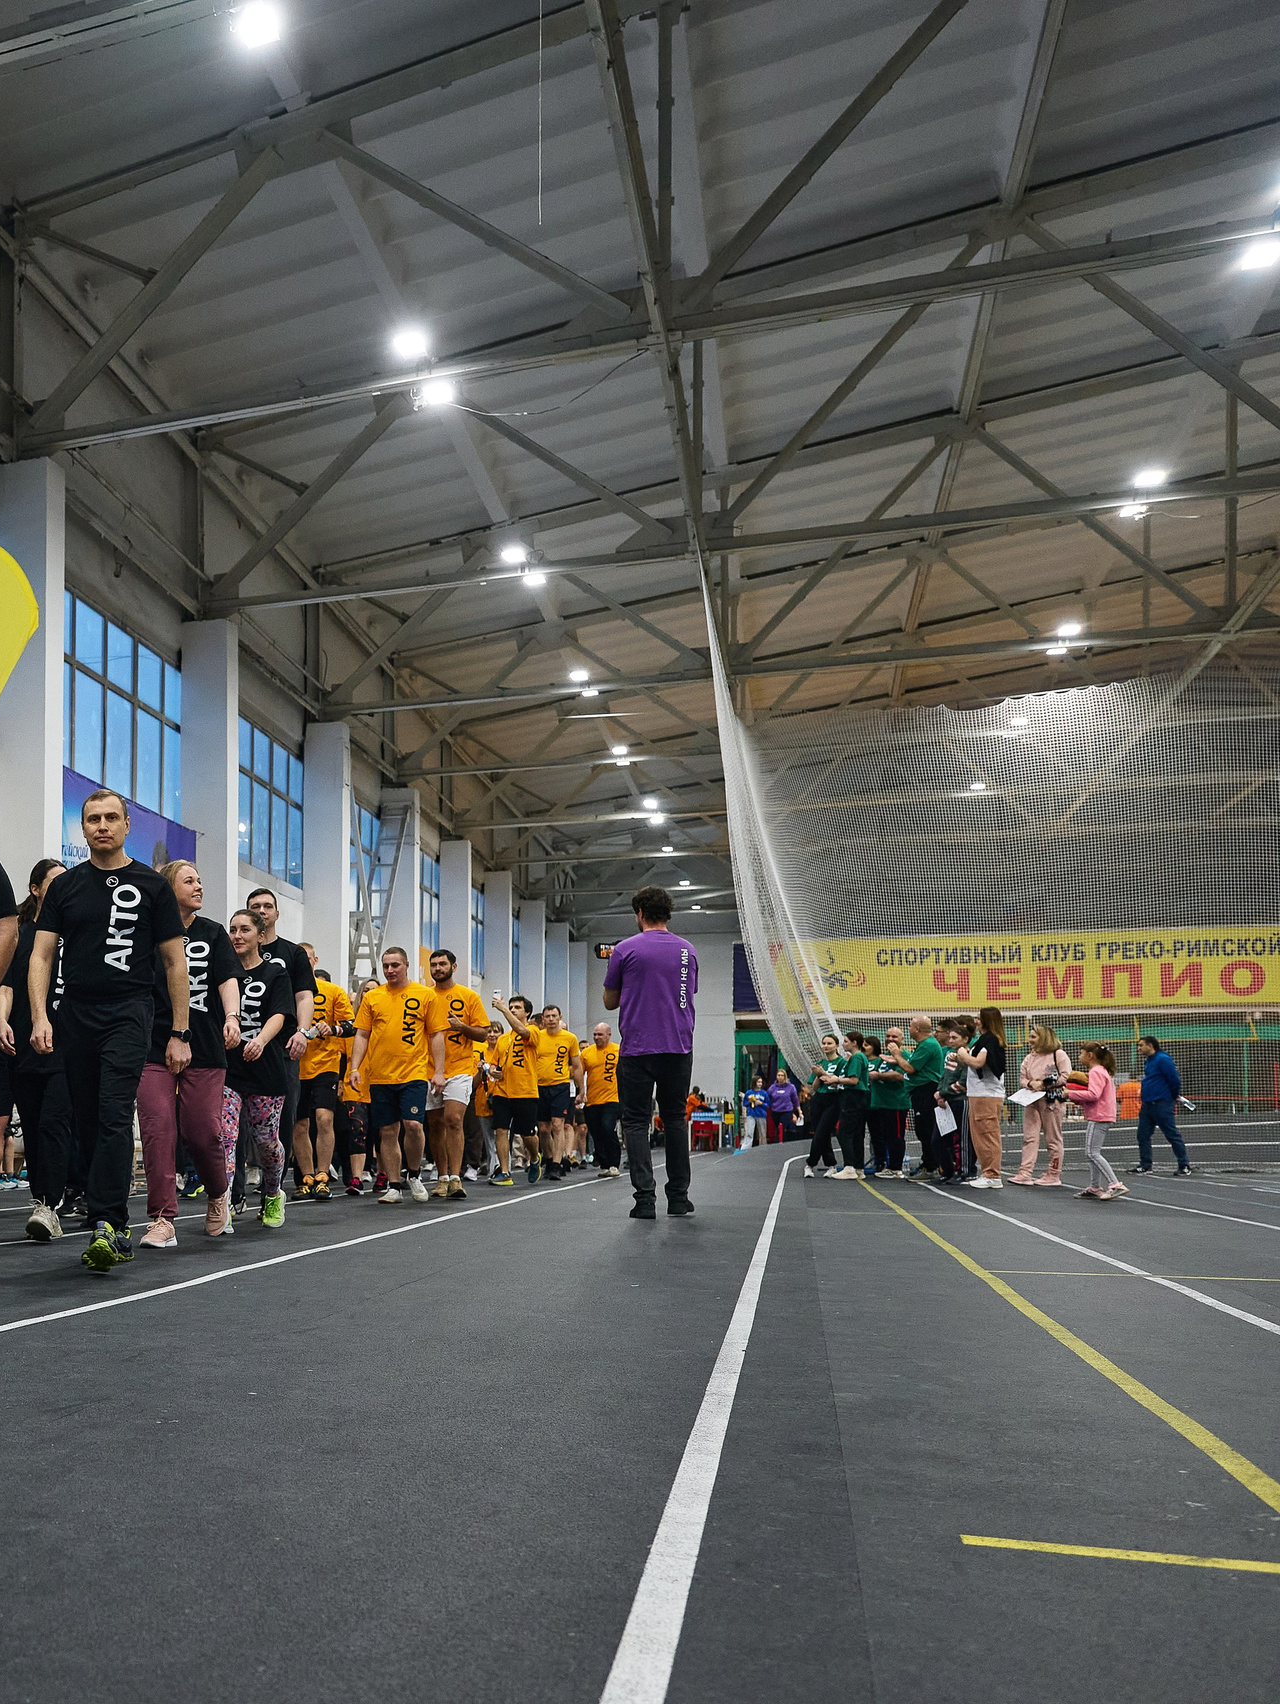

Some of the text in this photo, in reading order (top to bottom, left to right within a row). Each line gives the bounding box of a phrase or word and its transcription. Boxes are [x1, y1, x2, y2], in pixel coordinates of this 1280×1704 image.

[104, 884, 142, 972] АКТО
[680, 948, 689, 965] мы
[876, 932, 1280, 967] СПОРТИВНЫЙ КЛУБ ГРЕКО-РИМСКОЙ
[186, 941, 210, 1013] АКТО
[680, 967, 689, 981] не
[933, 960, 1266, 1002] ЧЕМПИО
[240, 981, 266, 1042] АКТО
[402, 997, 420, 1046] АКТО
[554, 1045, 567, 1075] АКТО
[604, 1053, 616, 1083] АКТО
